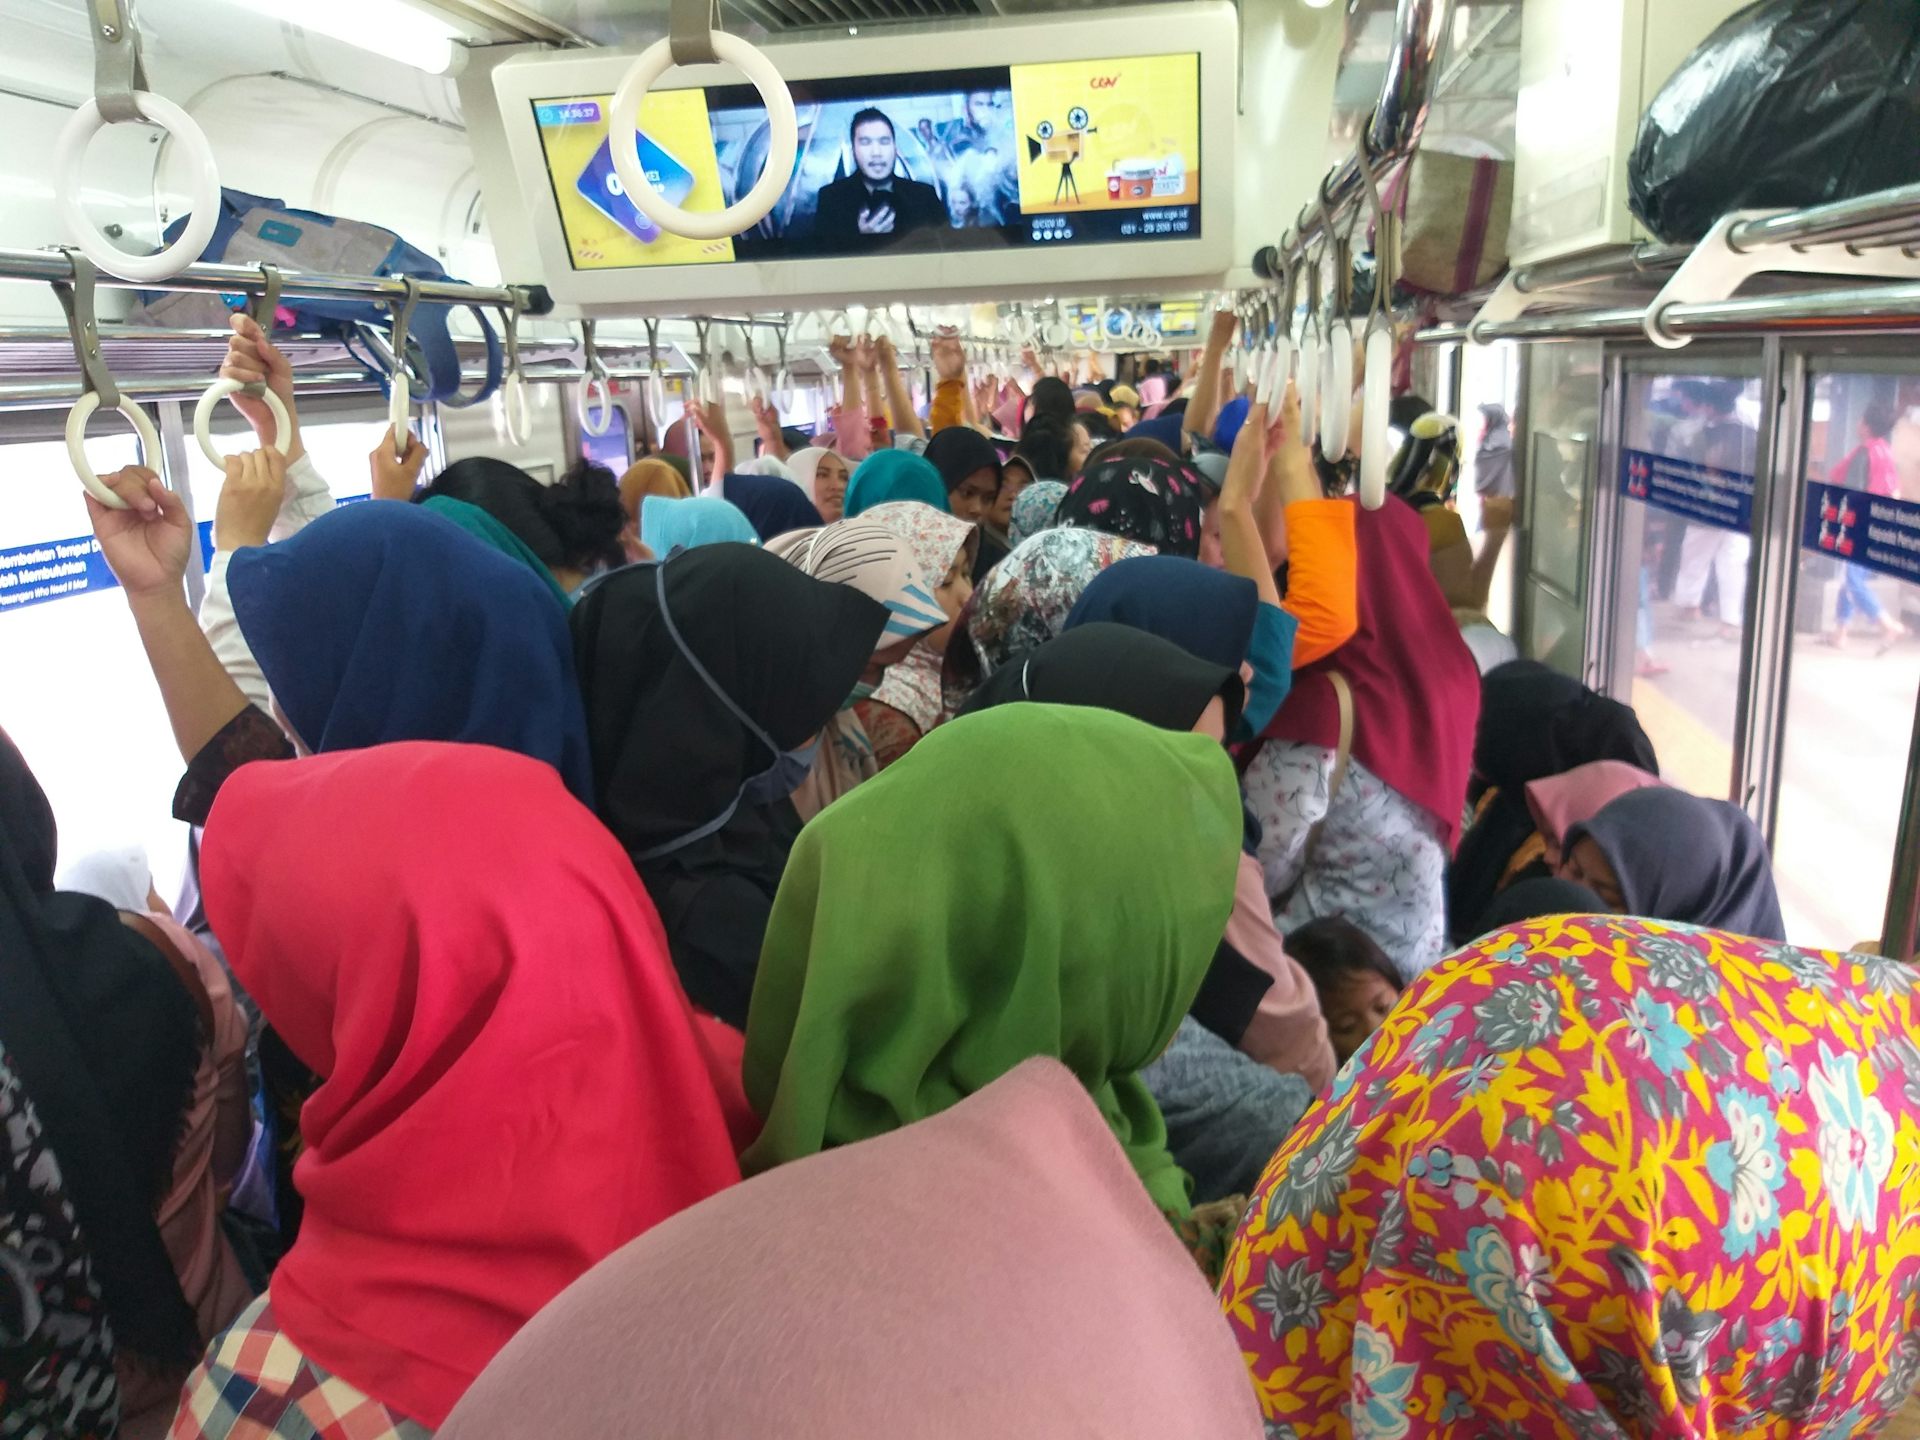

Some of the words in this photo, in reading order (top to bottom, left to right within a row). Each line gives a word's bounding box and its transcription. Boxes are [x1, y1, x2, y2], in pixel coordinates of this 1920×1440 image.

[55, 541, 91, 559] Tempat
[19, 561, 87, 584] Membutuhkan
[34, 587, 50, 599] Who
[50, 582, 68, 595] Need
